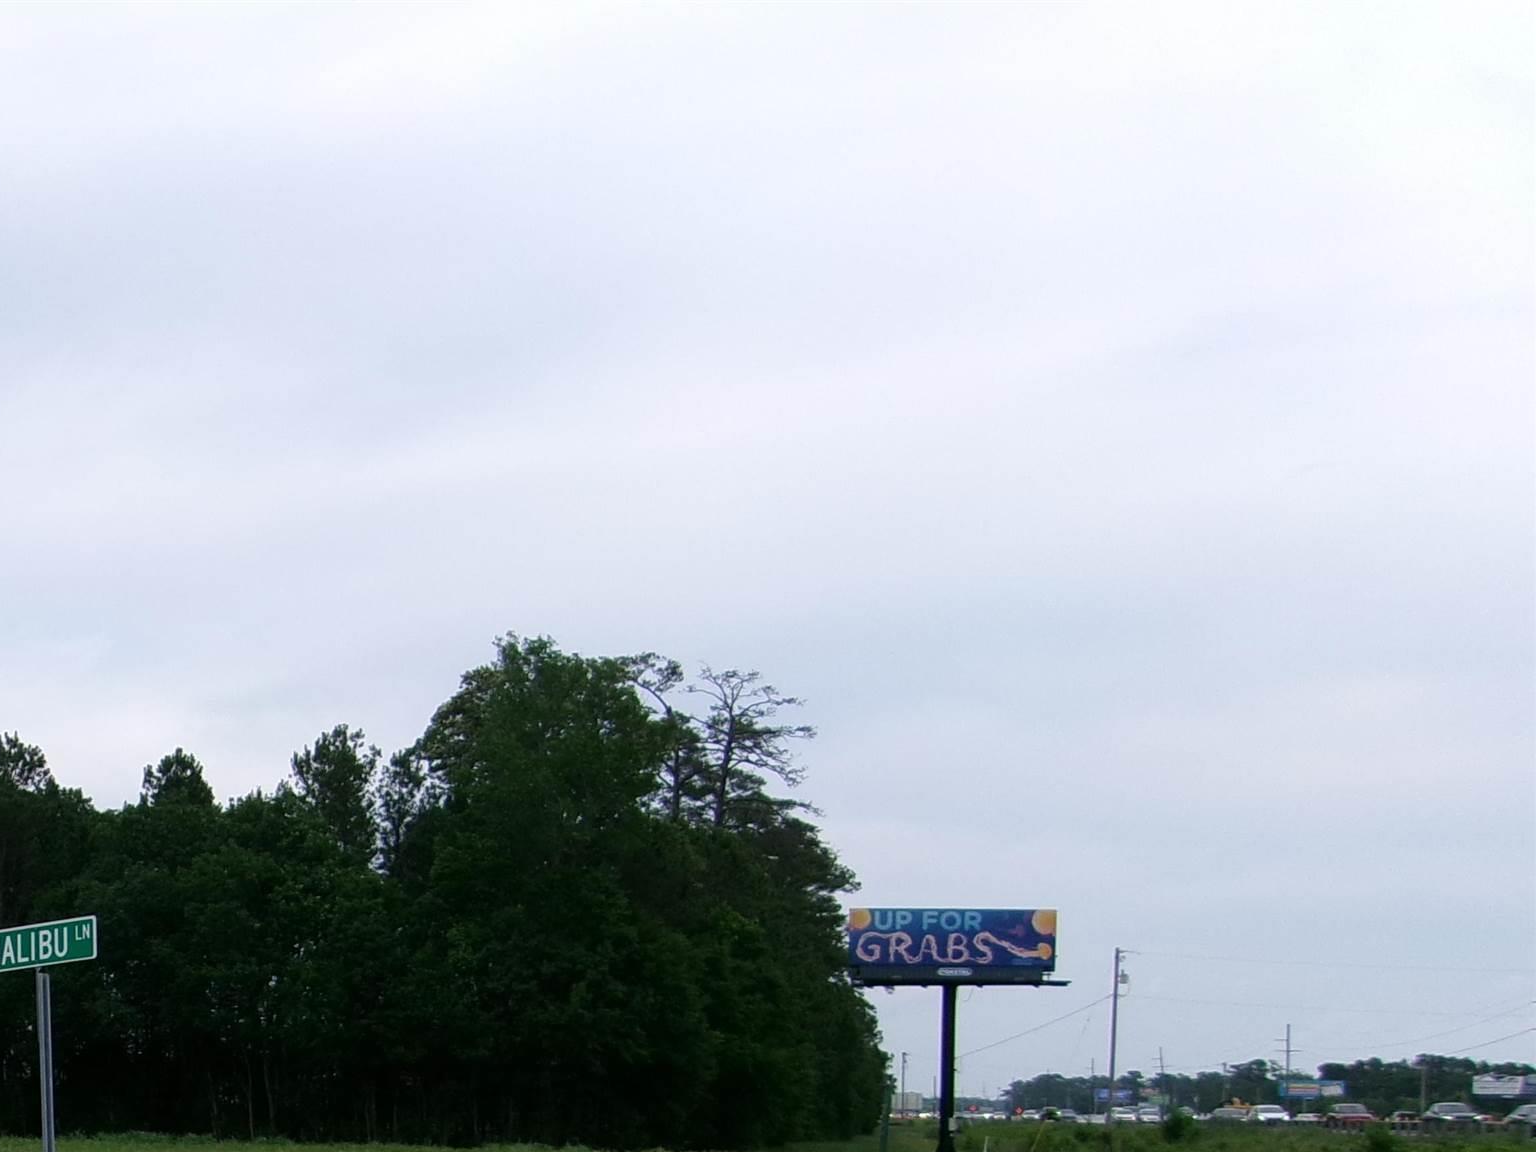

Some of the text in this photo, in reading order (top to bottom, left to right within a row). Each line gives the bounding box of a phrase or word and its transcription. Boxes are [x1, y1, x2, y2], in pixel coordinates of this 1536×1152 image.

[873, 910, 983, 931] UP FOR
[74, 923, 91, 941] LN
[855, 931, 995, 964] GRABS
